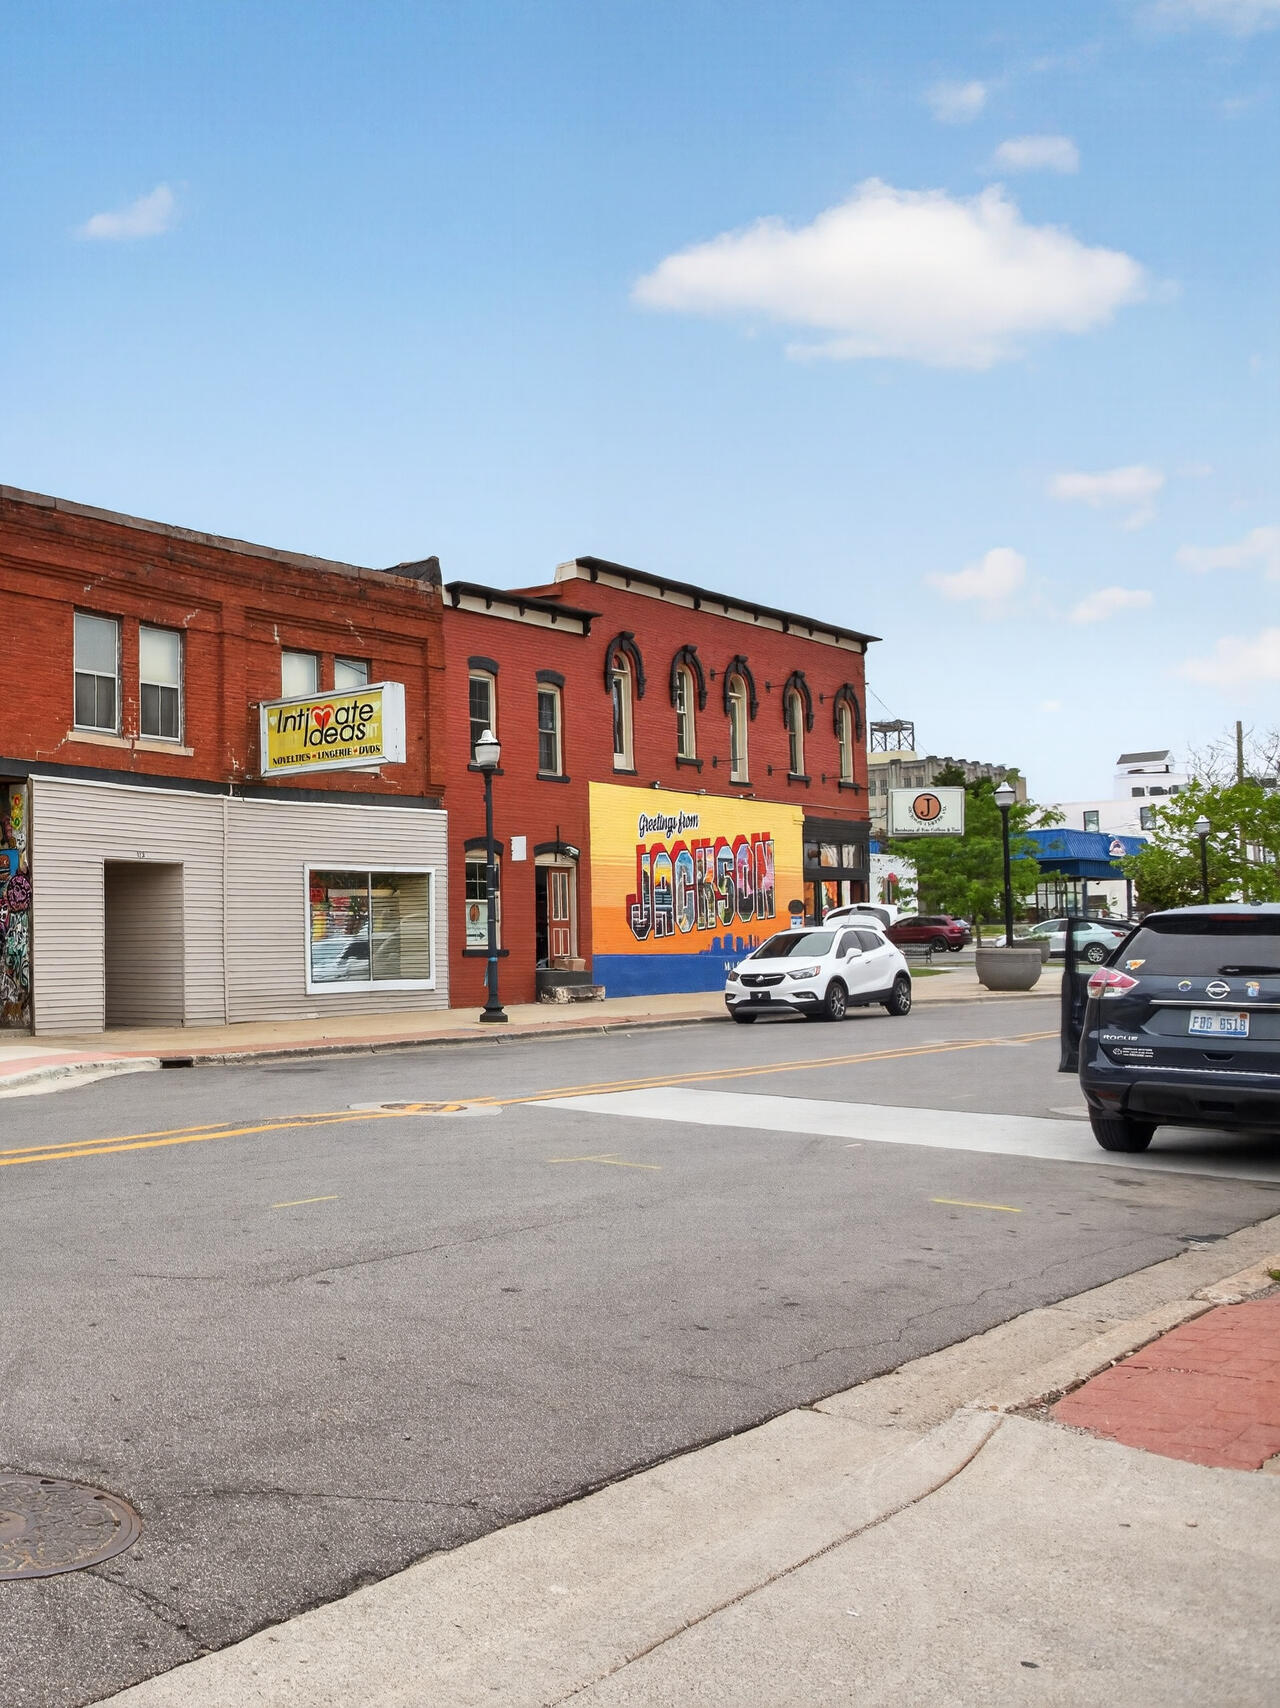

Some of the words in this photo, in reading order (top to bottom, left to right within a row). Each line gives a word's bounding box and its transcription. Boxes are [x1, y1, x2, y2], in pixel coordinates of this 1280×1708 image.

[304, 719, 366, 747] Ideas
[272, 752, 311, 766] NOVELTIES
[317, 747, 352, 760] LINGERIE
[921, 798, 933, 817] J
[639, 813, 677, 838] Greetings
[677, 811, 698, 834] from
[626, 833, 776, 941] JACKSON
